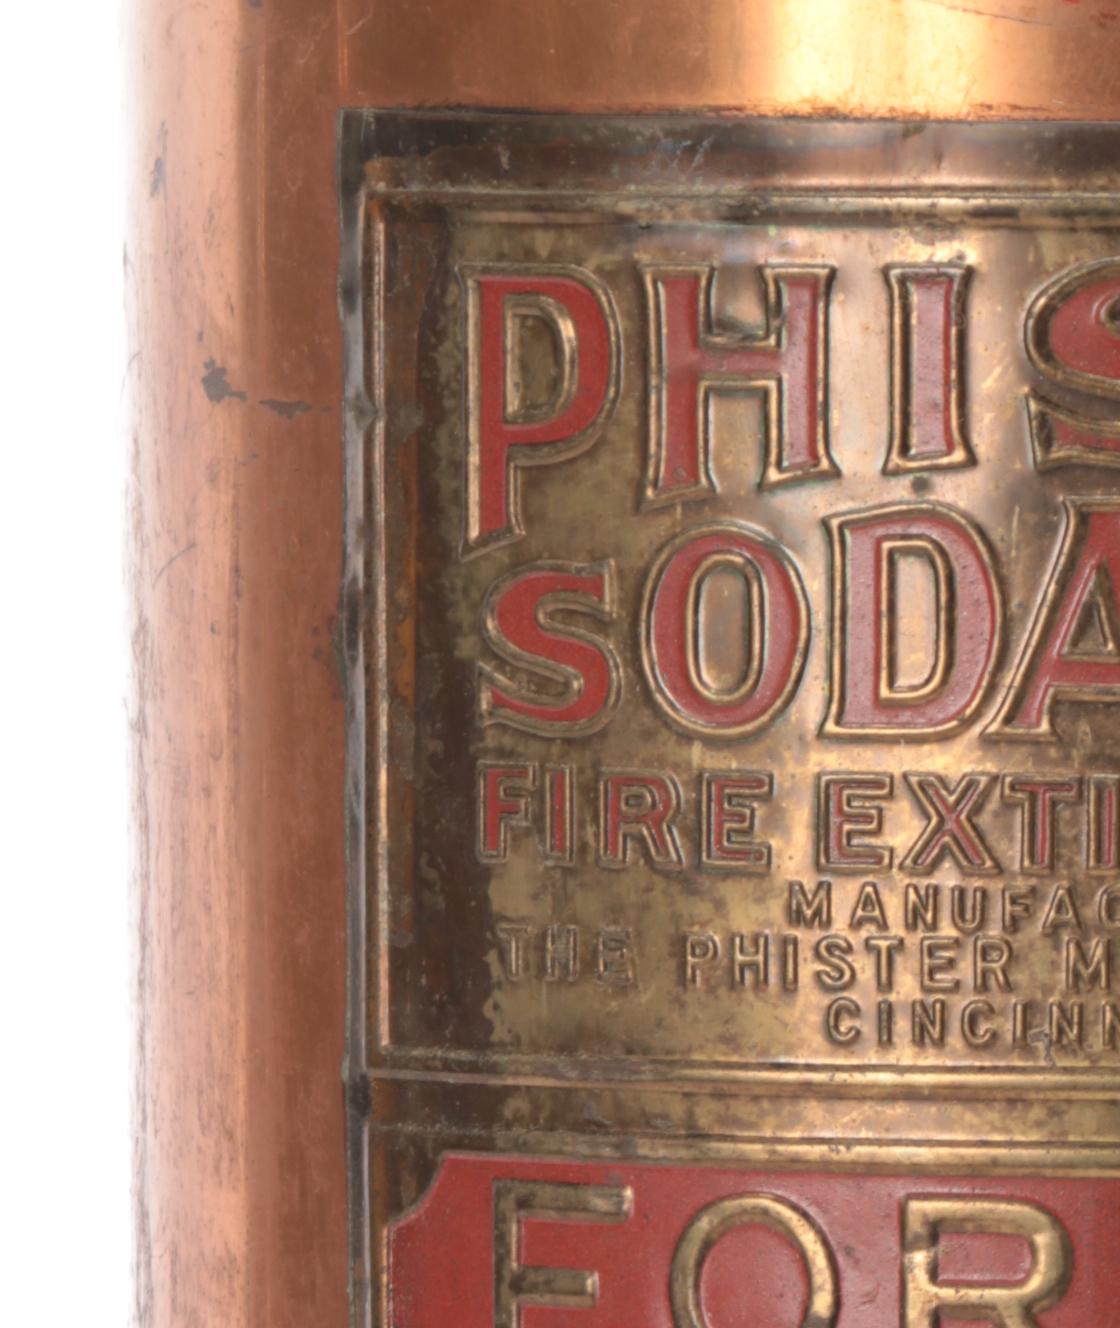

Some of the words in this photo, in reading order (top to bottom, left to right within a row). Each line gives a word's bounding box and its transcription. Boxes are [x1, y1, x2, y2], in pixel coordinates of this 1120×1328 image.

[477, 759, 774, 874] FIRE
[499, 923, 640, 990] THE
[683, 931, 1014, 993] PHISTER
